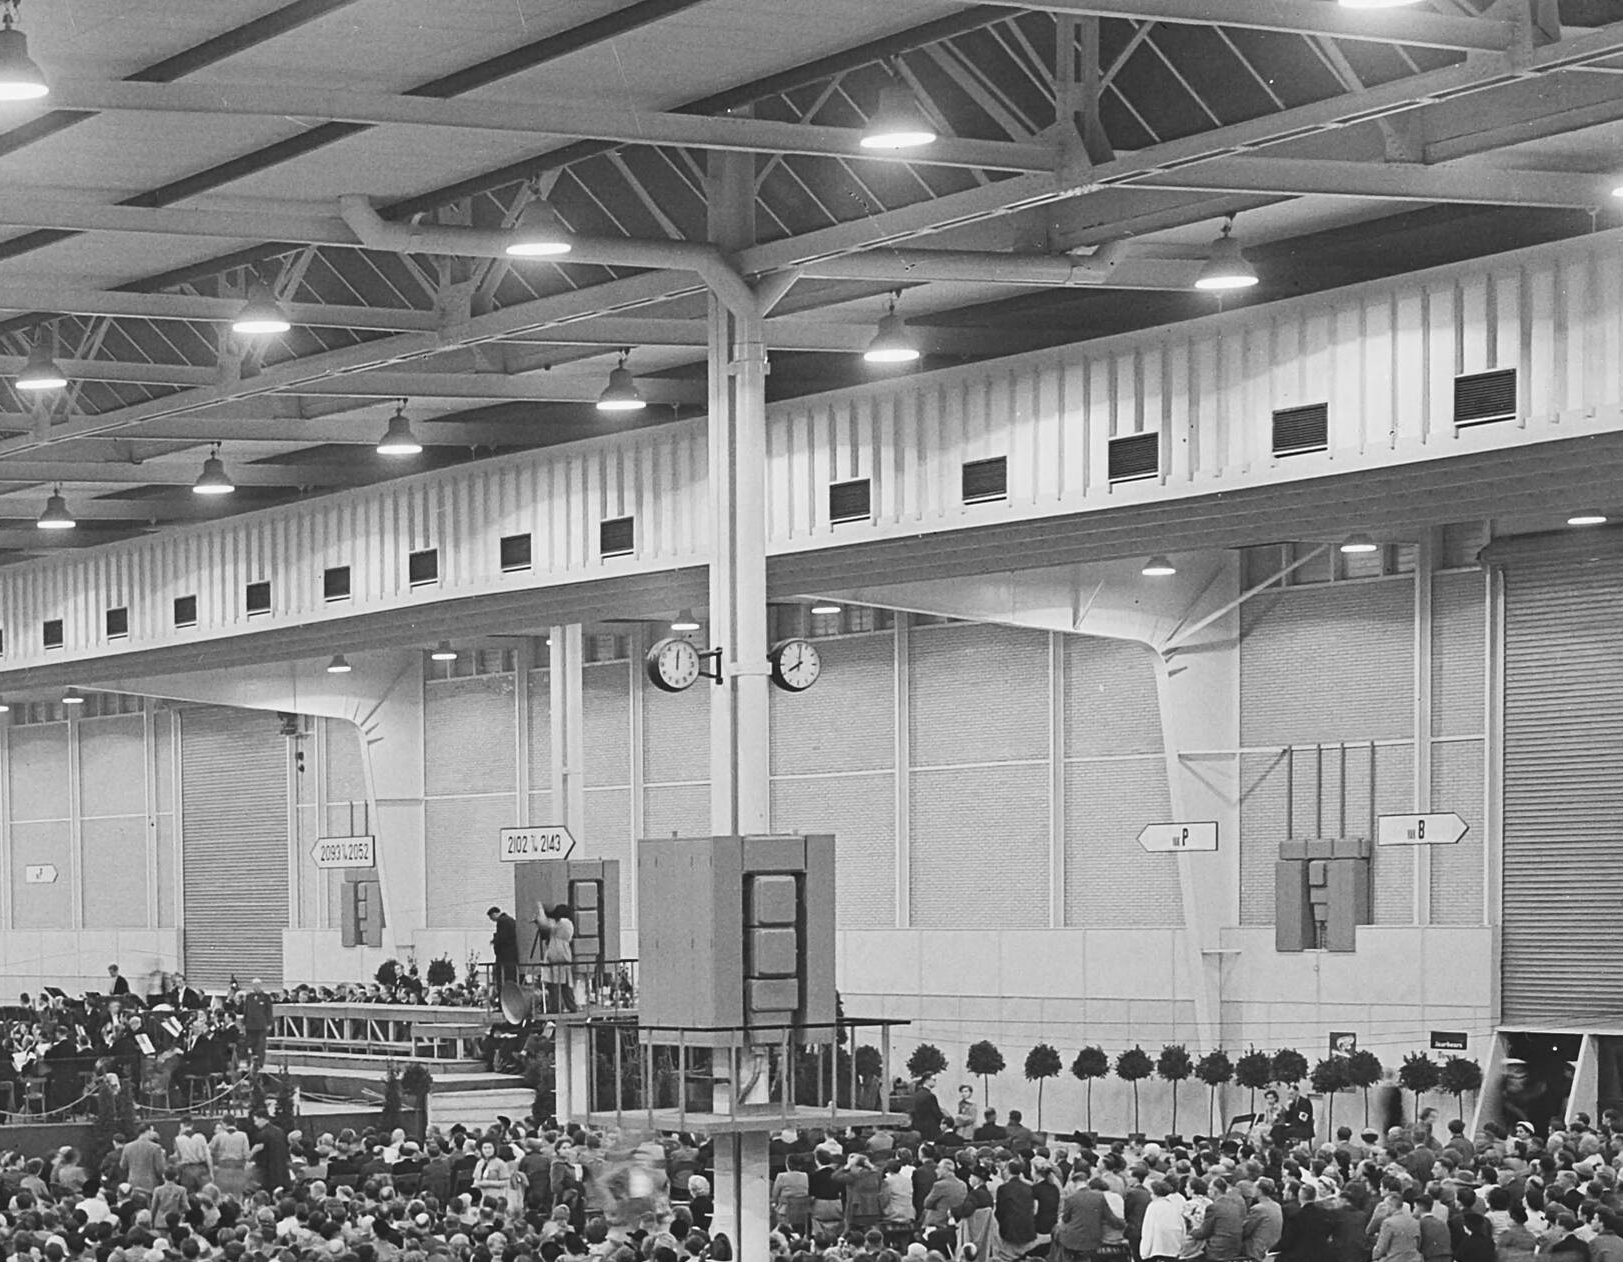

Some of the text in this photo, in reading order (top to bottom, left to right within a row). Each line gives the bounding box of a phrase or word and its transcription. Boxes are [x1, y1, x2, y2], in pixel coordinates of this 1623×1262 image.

[507, 835, 528, 853] 2102
[540, 833, 561, 852] 2143
[1182, 827, 1190, 847] P
[321, 845, 341, 862] 2093
[348, 843, 369, 860] 2052
